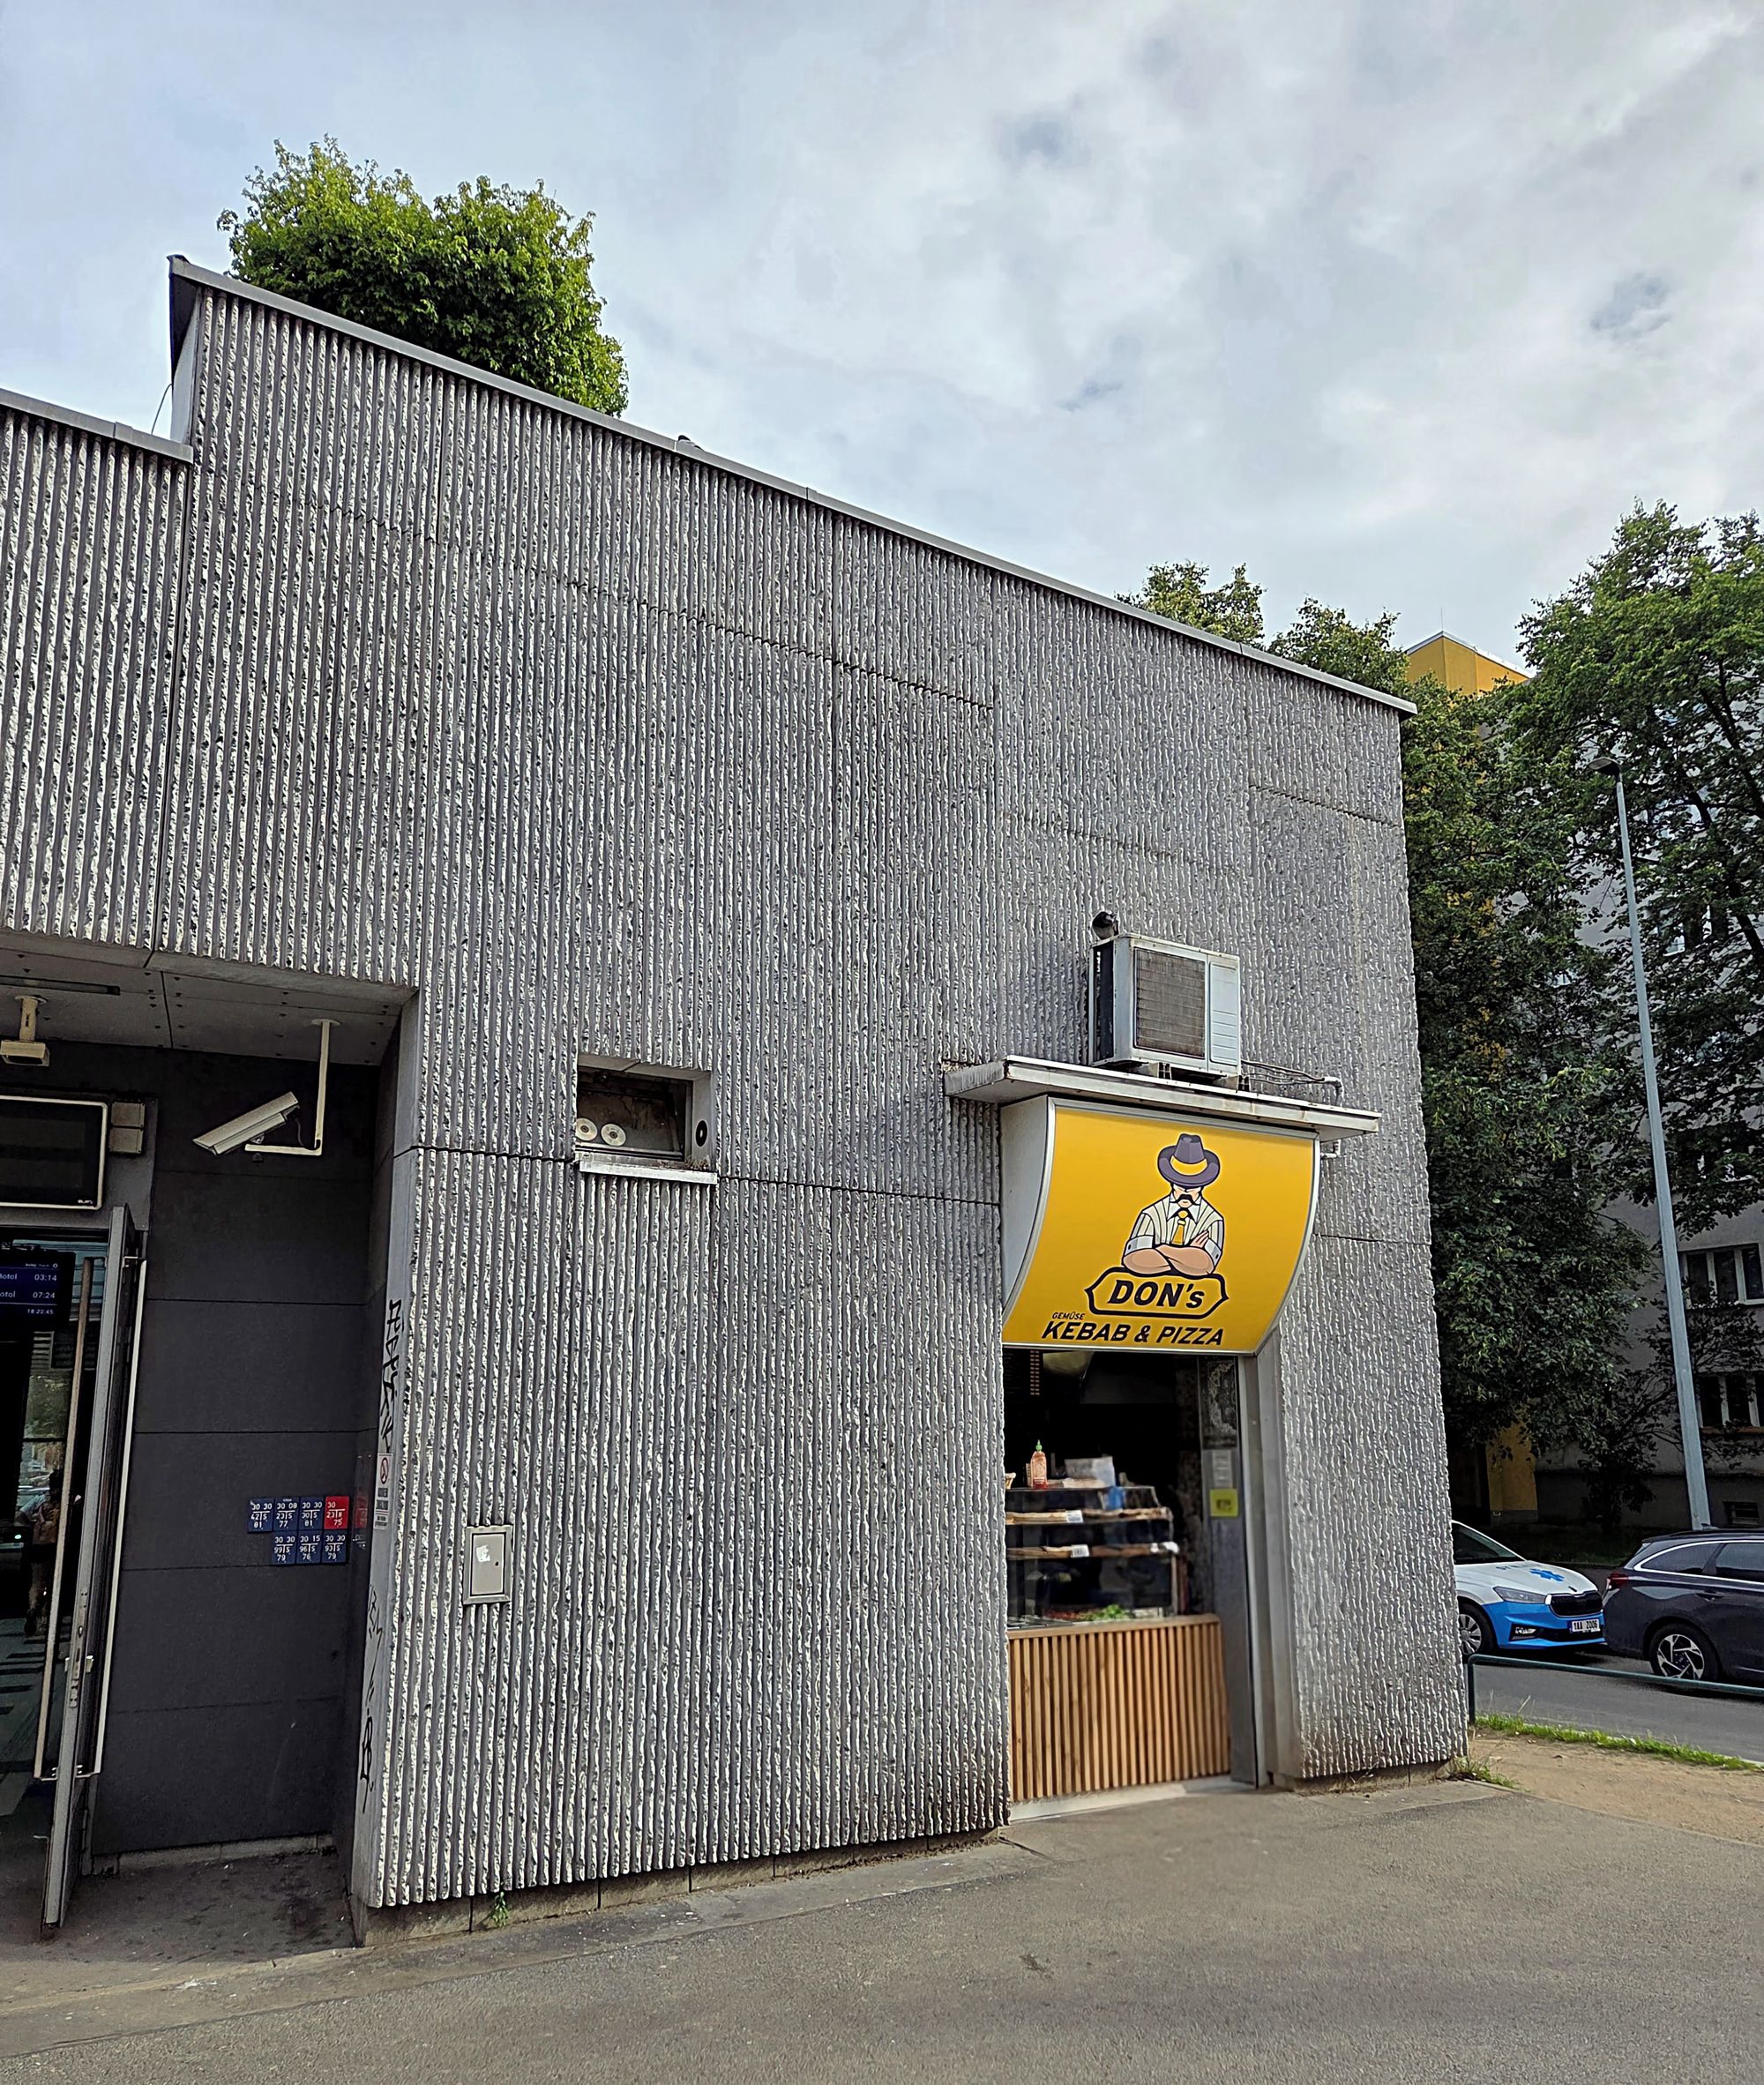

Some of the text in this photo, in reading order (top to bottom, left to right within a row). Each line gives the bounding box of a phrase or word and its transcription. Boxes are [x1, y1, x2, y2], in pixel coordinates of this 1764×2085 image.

[1106, 1279, 1205, 1309] DON's
[1052, 1312, 1085, 1320] GEMÜSE
[1042, 1320, 1224, 1346] KEBAB & PIZZA
